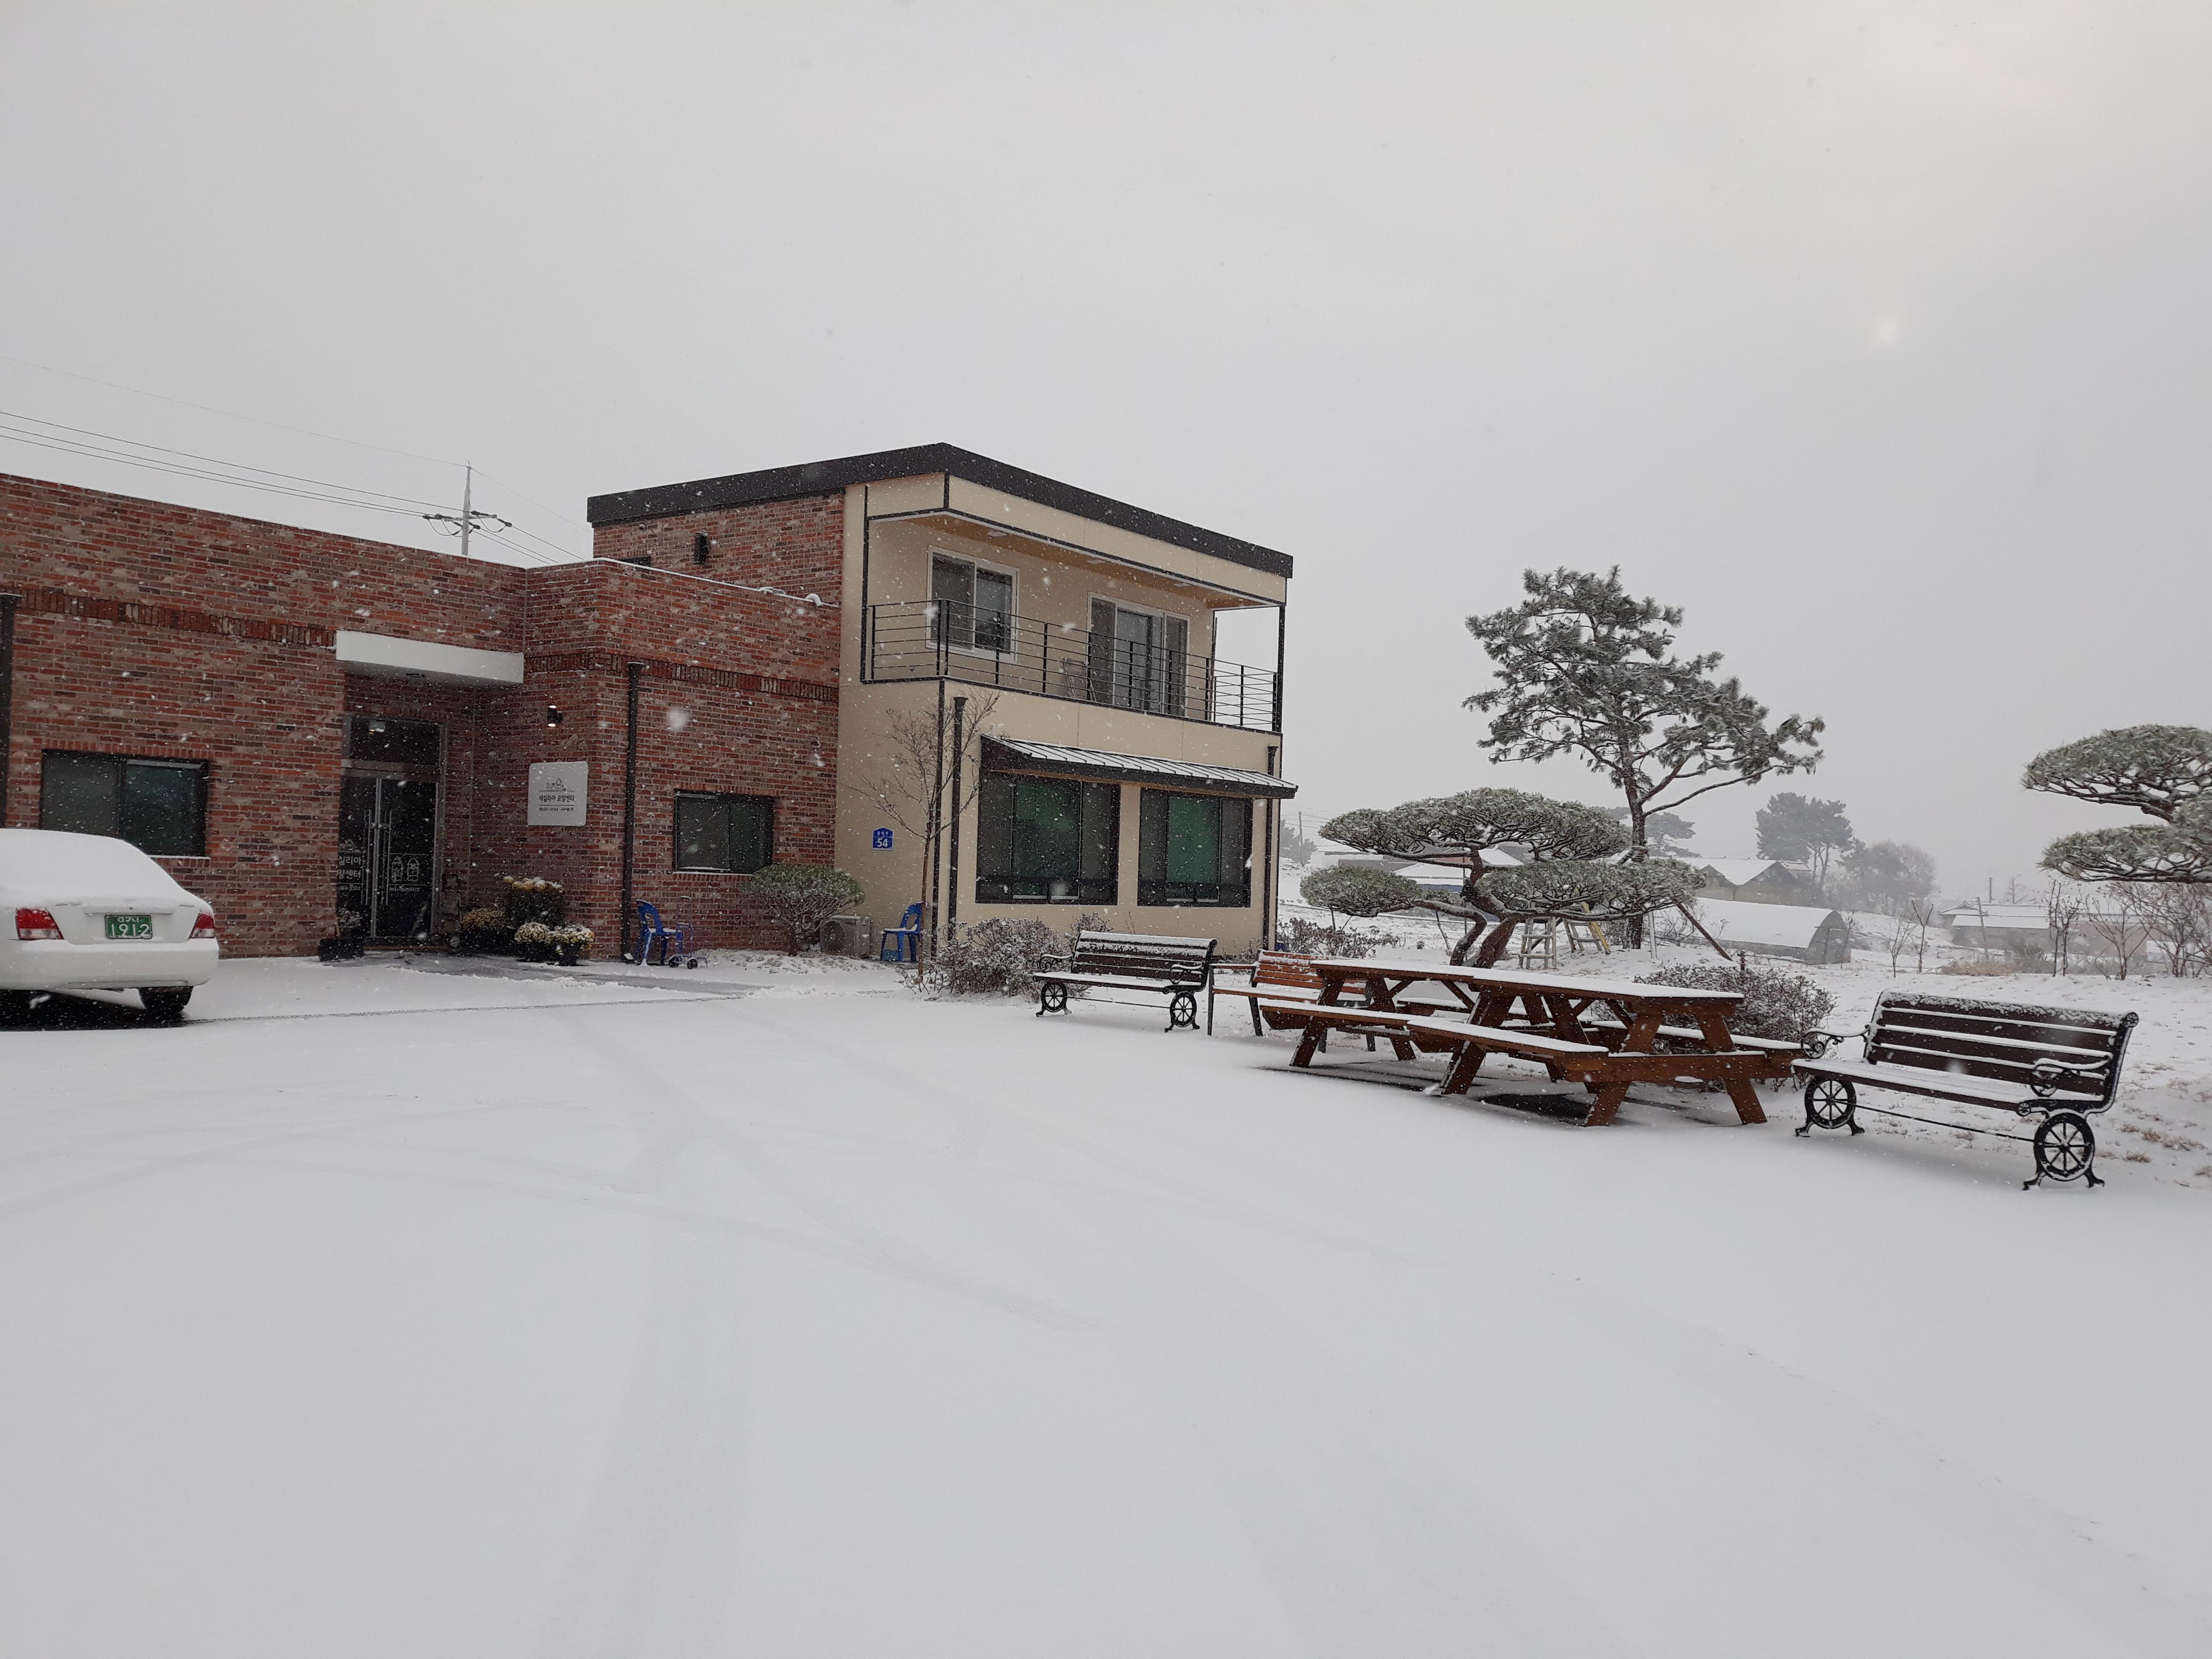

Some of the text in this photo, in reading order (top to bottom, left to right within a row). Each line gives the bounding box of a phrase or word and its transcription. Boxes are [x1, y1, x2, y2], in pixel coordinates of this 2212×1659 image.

[557, 795, 574, 803] 요양센터
[877, 836, 888, 848] 54
[111, 923, 150, 937] 1912
